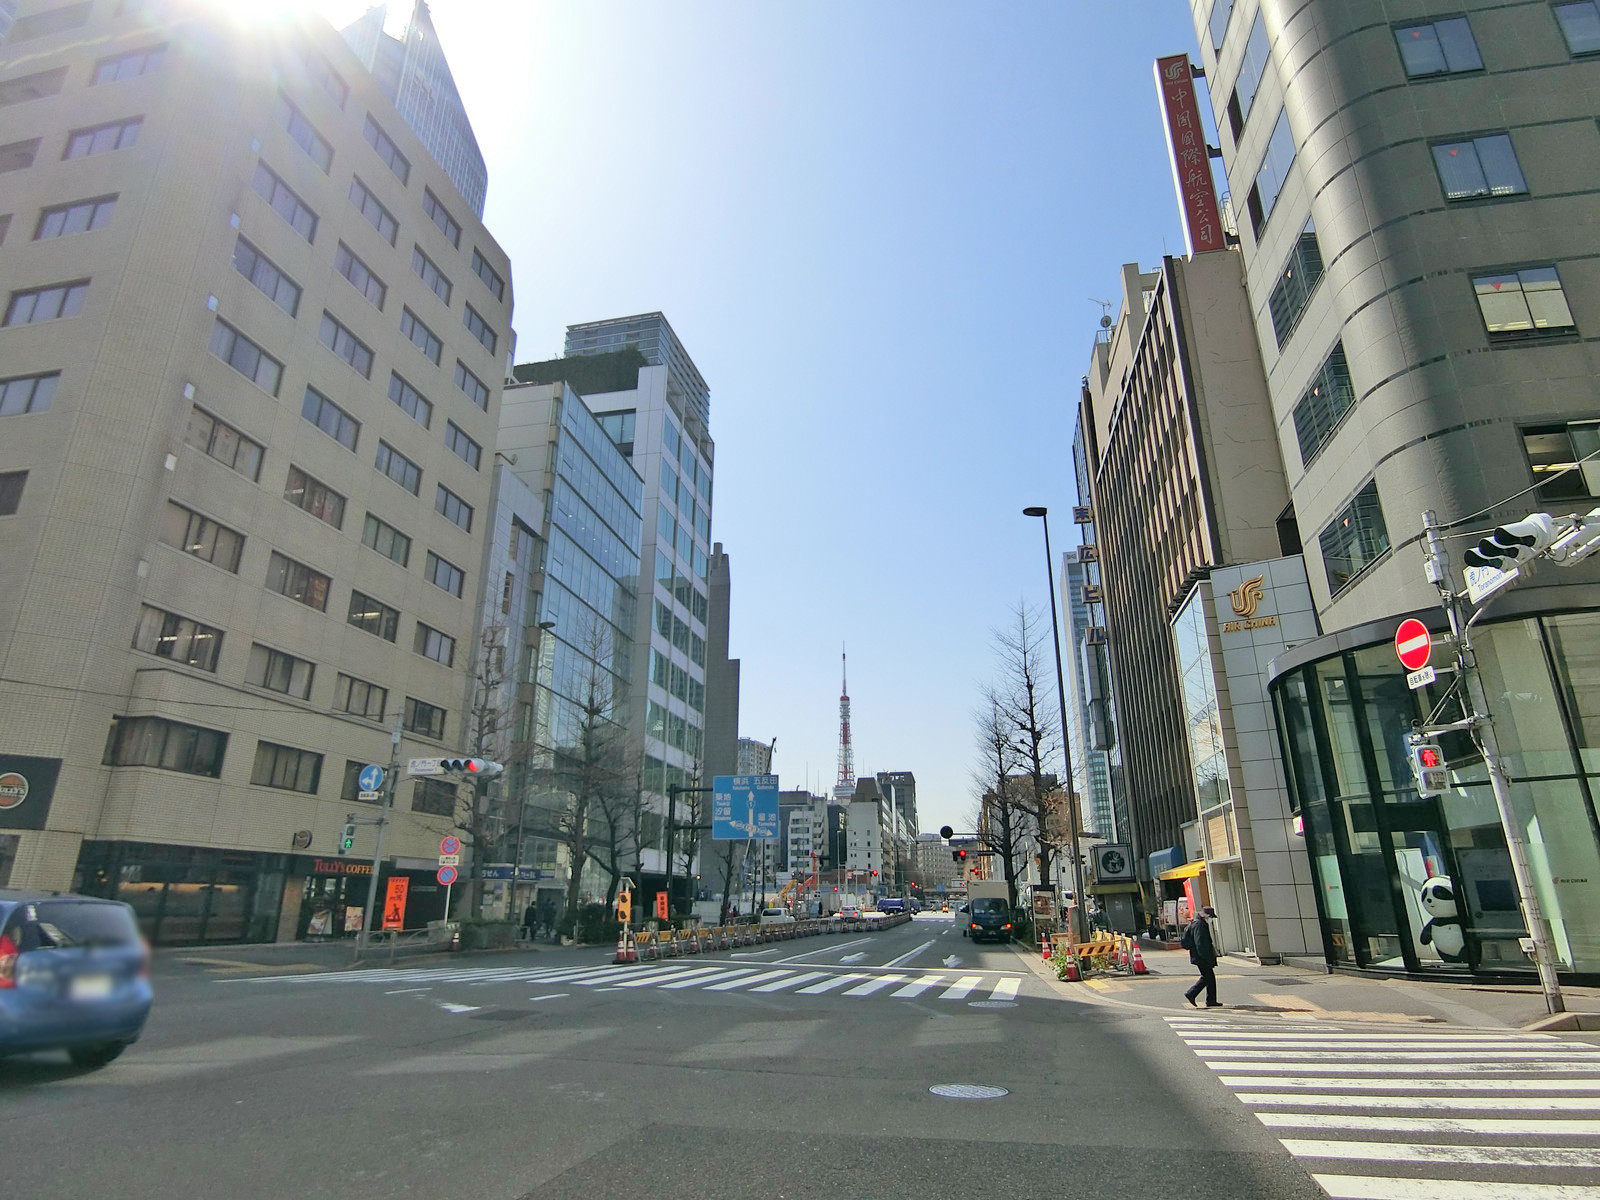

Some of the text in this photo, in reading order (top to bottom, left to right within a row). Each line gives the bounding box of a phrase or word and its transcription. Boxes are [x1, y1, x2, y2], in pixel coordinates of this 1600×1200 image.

[1223, 616, 1276, 633] AIR CHINA
[754, 776, 777, 785] 五反田
